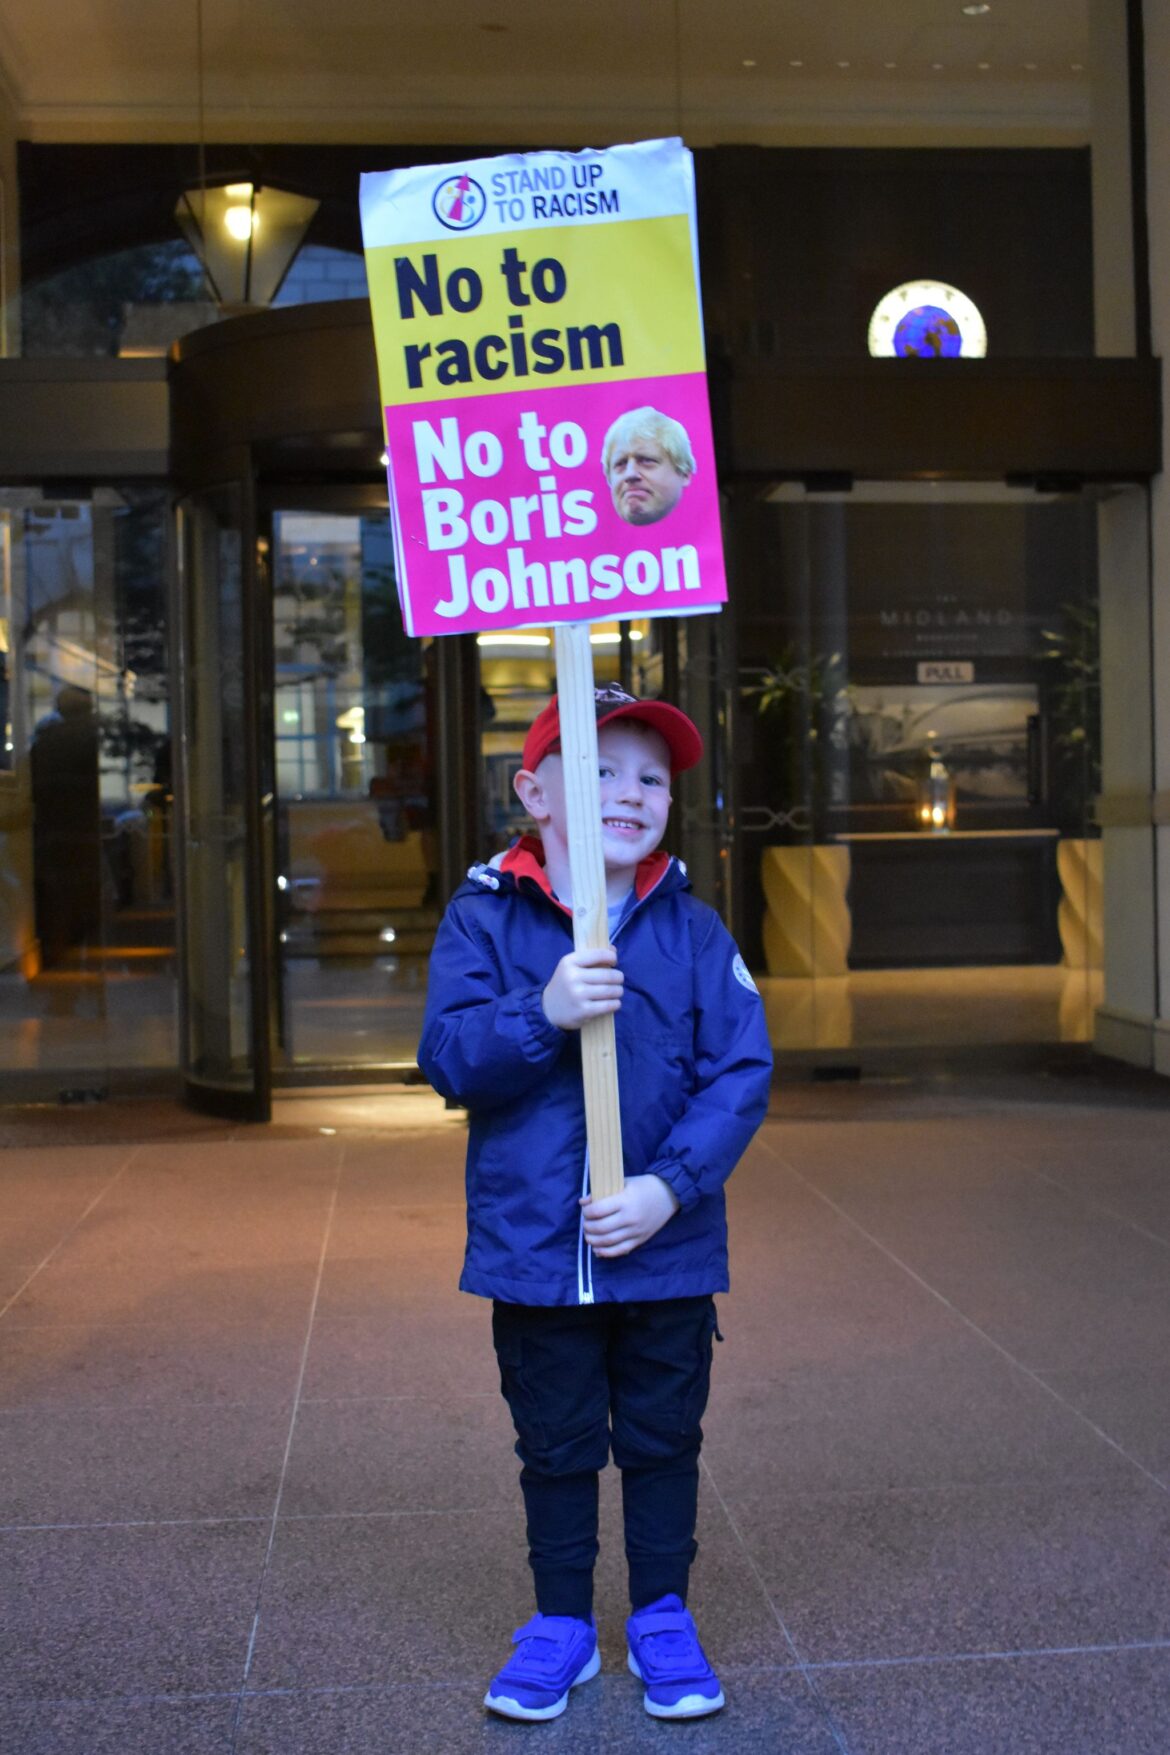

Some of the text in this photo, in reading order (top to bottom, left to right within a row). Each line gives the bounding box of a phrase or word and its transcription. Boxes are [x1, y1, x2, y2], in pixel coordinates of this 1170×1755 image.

[491, 164, 603, 197] STAND UP
[494, 190, 620, 223] TO RACISM
[394, 248, 567, 319] No to
[403, 314, 625, 389] racism
[412, 411, 588, 484] No to
[421, 475, 598, 551] Boris
[433, 544, 701, 618] Johnson
[880, 609, 1012, 626] MIDLAND
[925, 666, 963, 681] PULL
